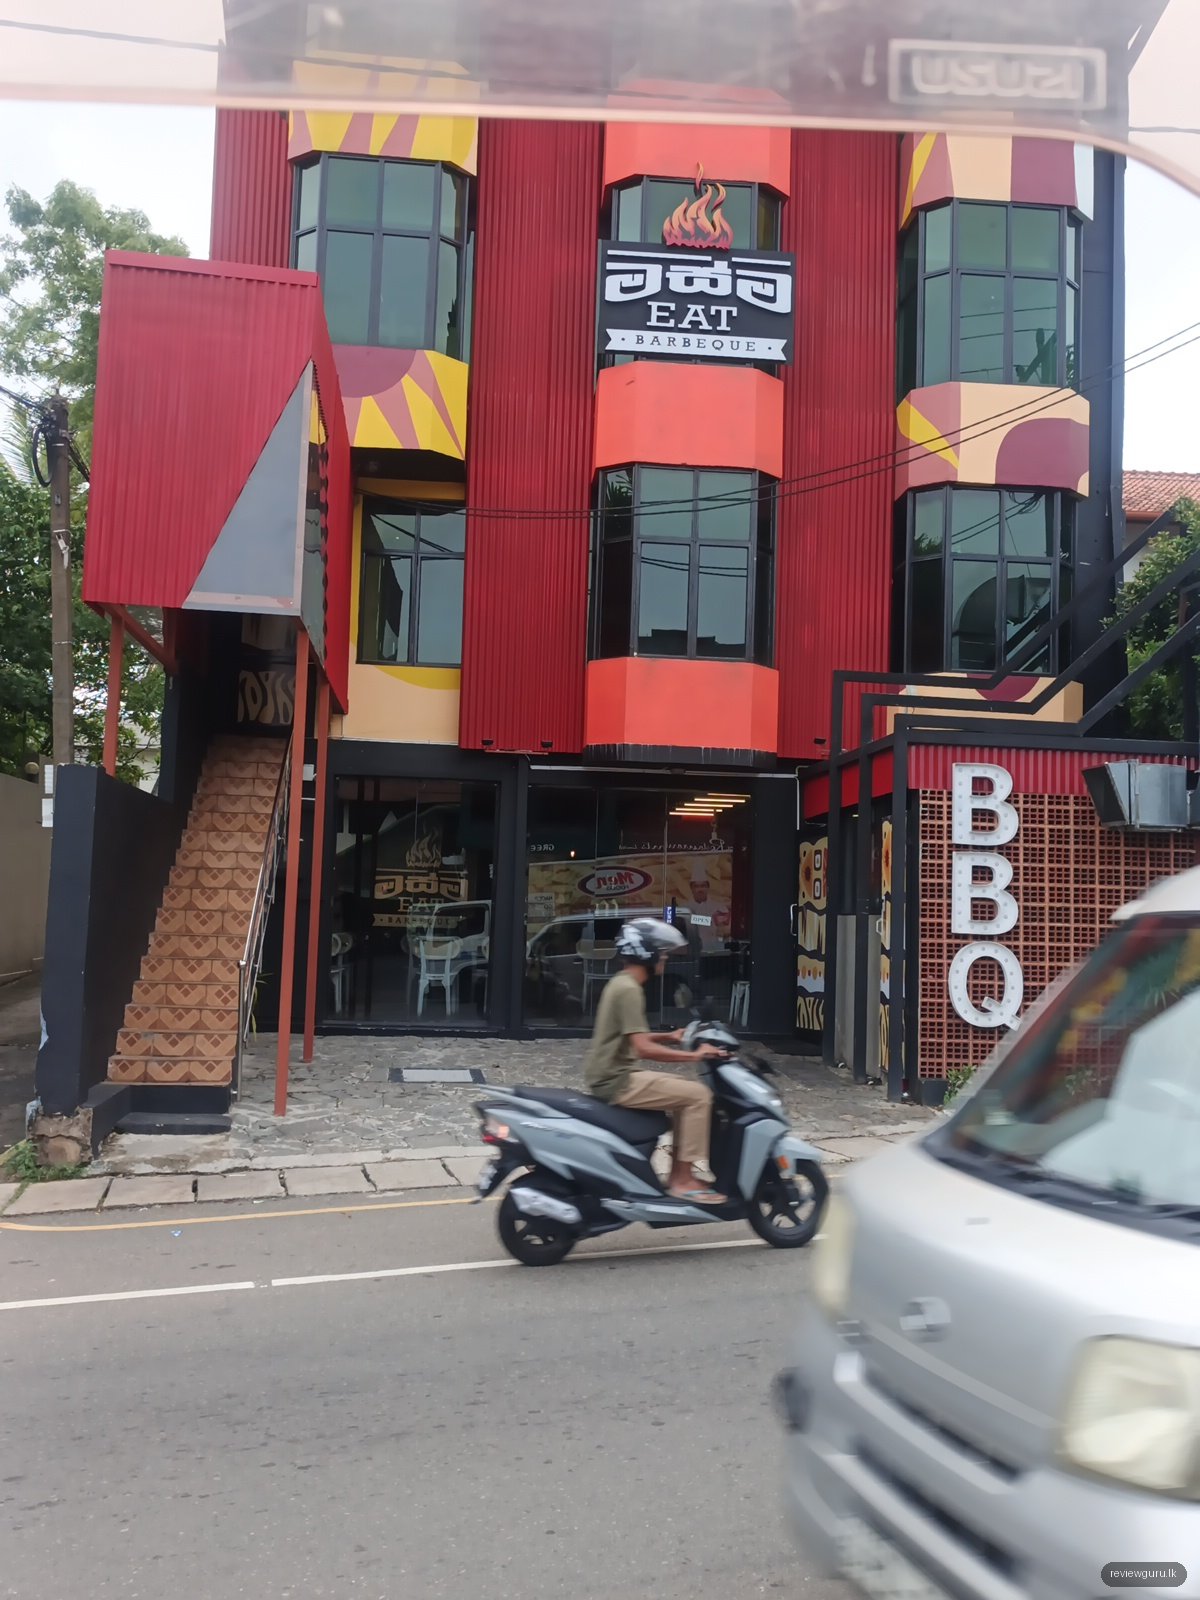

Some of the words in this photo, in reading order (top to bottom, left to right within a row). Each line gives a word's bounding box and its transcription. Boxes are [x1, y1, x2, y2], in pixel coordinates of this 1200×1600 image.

[646, 301, 738, 332] EAT
[635, 334, 756, 353] BARBEQUE
[947, 762, 1024, 1032] BBQ
[692, 916, 710, 924] OPEN
